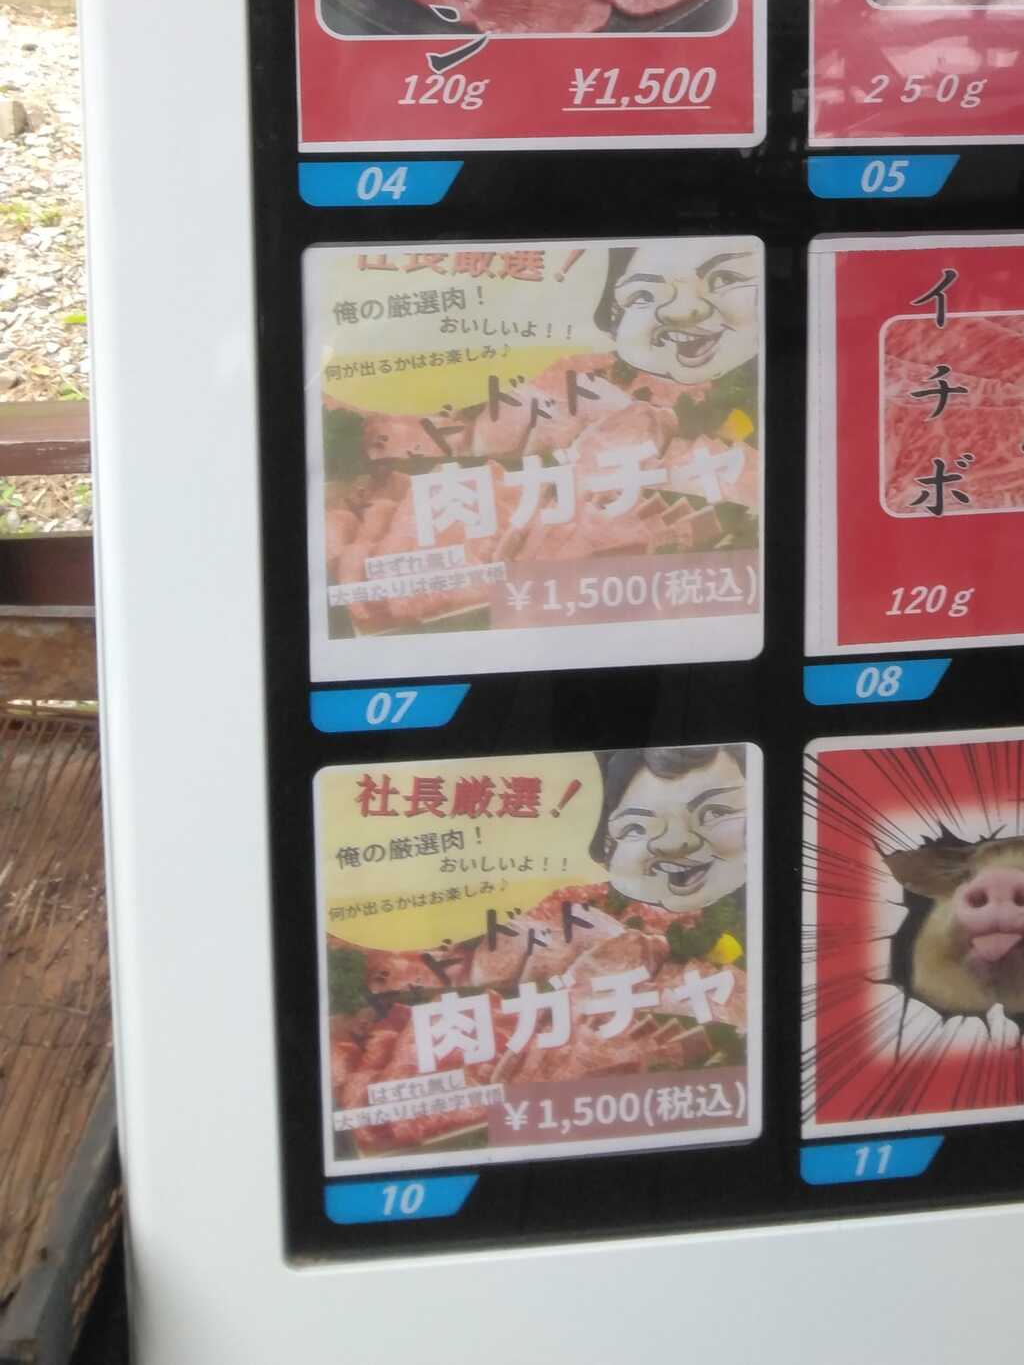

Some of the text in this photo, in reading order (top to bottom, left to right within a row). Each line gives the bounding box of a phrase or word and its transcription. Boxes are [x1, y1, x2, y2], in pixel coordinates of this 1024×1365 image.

[398, 74, 490, 109] 120g
[567, 66, 717, 108] ¥1,500
[357, 167, 408, 200] 04
[860, 161, 909, 193] 05
[909, 269, 976, 517] イチボ
[412, 442, 745, 545] 肉ガチャ
[855, 666, 903, 698] 08
[366, 691, 418, 725] 07
[355, 773, 582, 819] 社長厳選！
[412, 965, 736, 1074] 肉ガチャ
[855, 1144, 894, 1176] 11
[382, 1183, 424, 1216] 10
